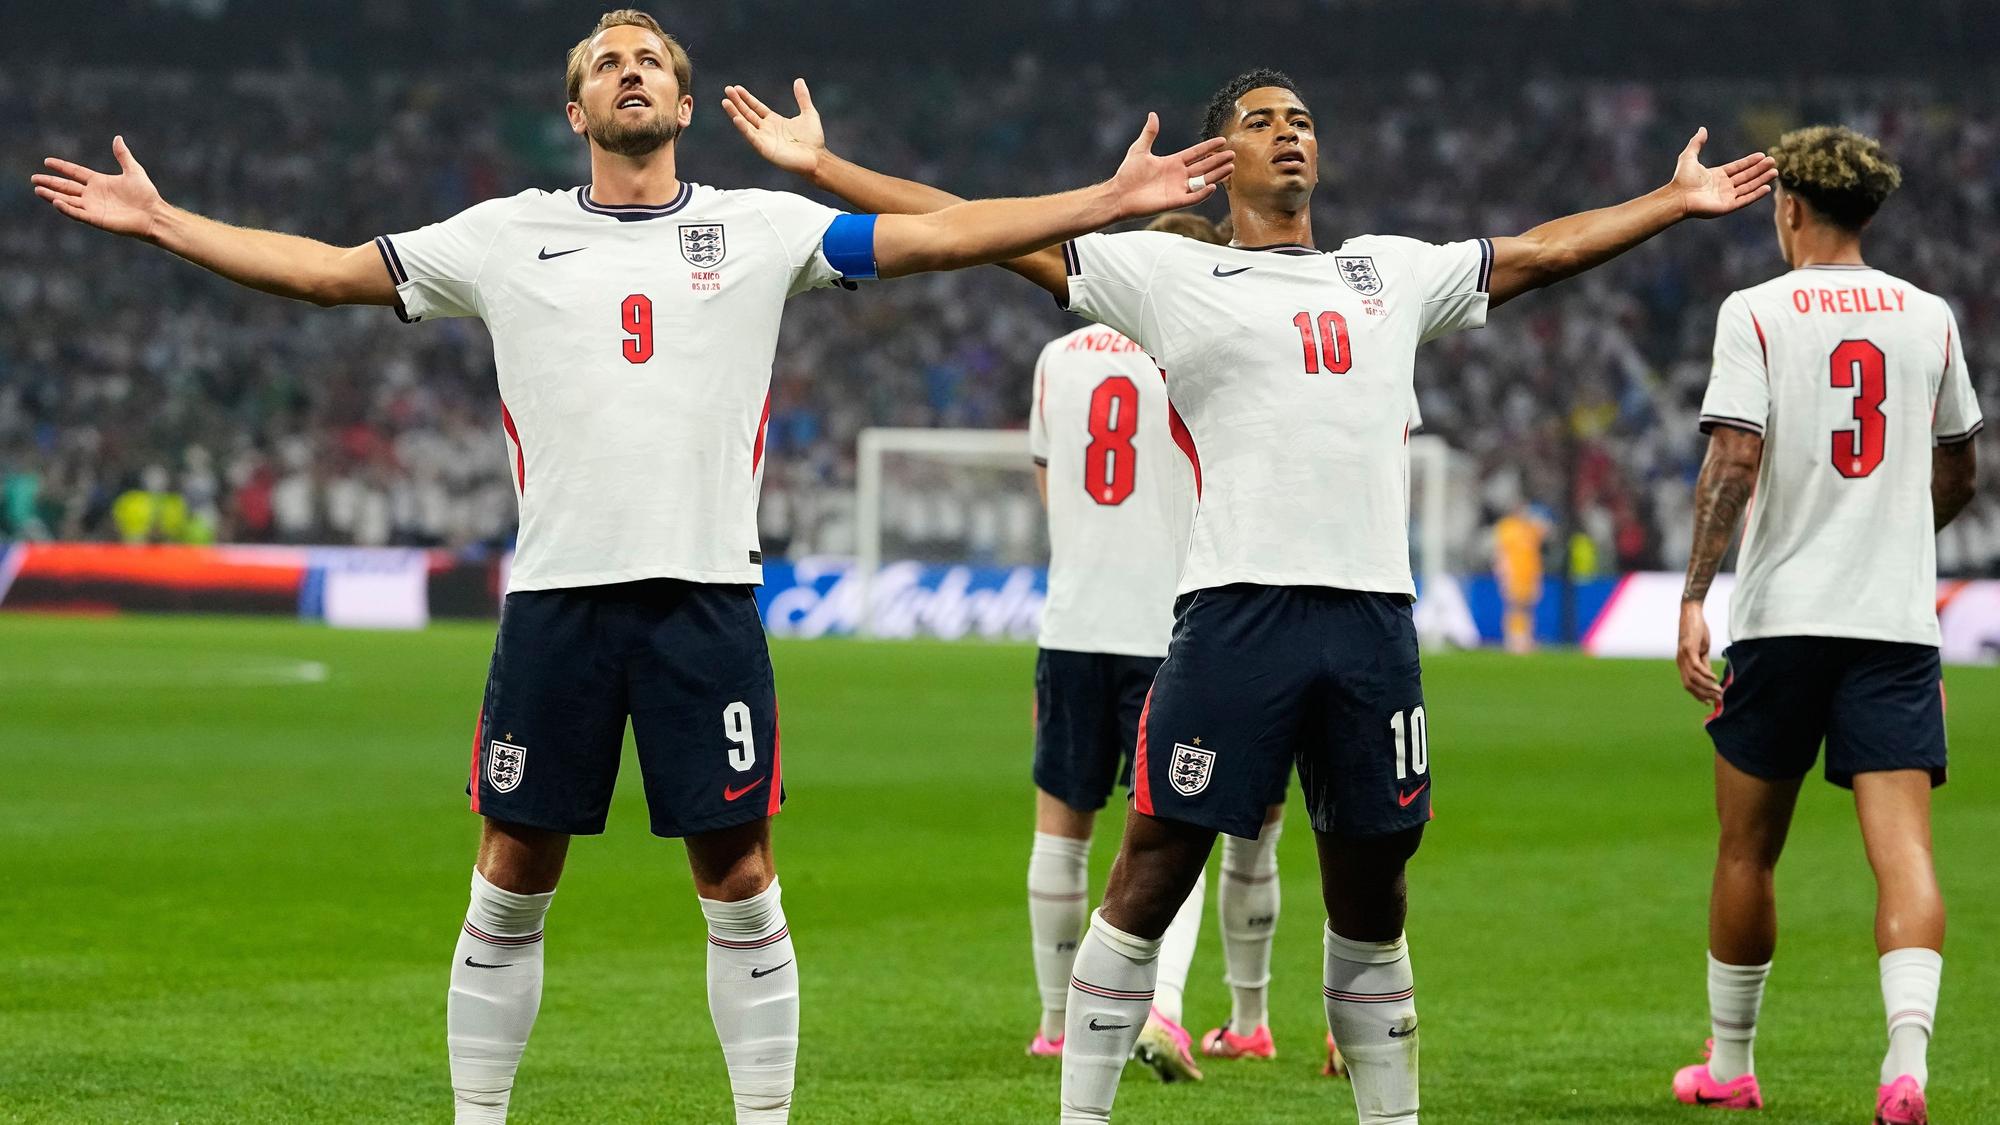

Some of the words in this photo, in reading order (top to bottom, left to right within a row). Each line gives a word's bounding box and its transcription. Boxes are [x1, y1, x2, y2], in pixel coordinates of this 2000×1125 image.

[691, 271, 720, 281] MEXICO
[1792, 288, 1905, 314] O'REILLY
[621, 293, 654, 364] 9
[1065, 332, 1144, 353] ANDER
[1292, 310, 1353, 375] 10
[1084, 375, 1139, 506] 8
[1829, 338, 1887, 479] 3
[723, 700, 756, 772] 9
[1390, 705, 1428, 780] 10
